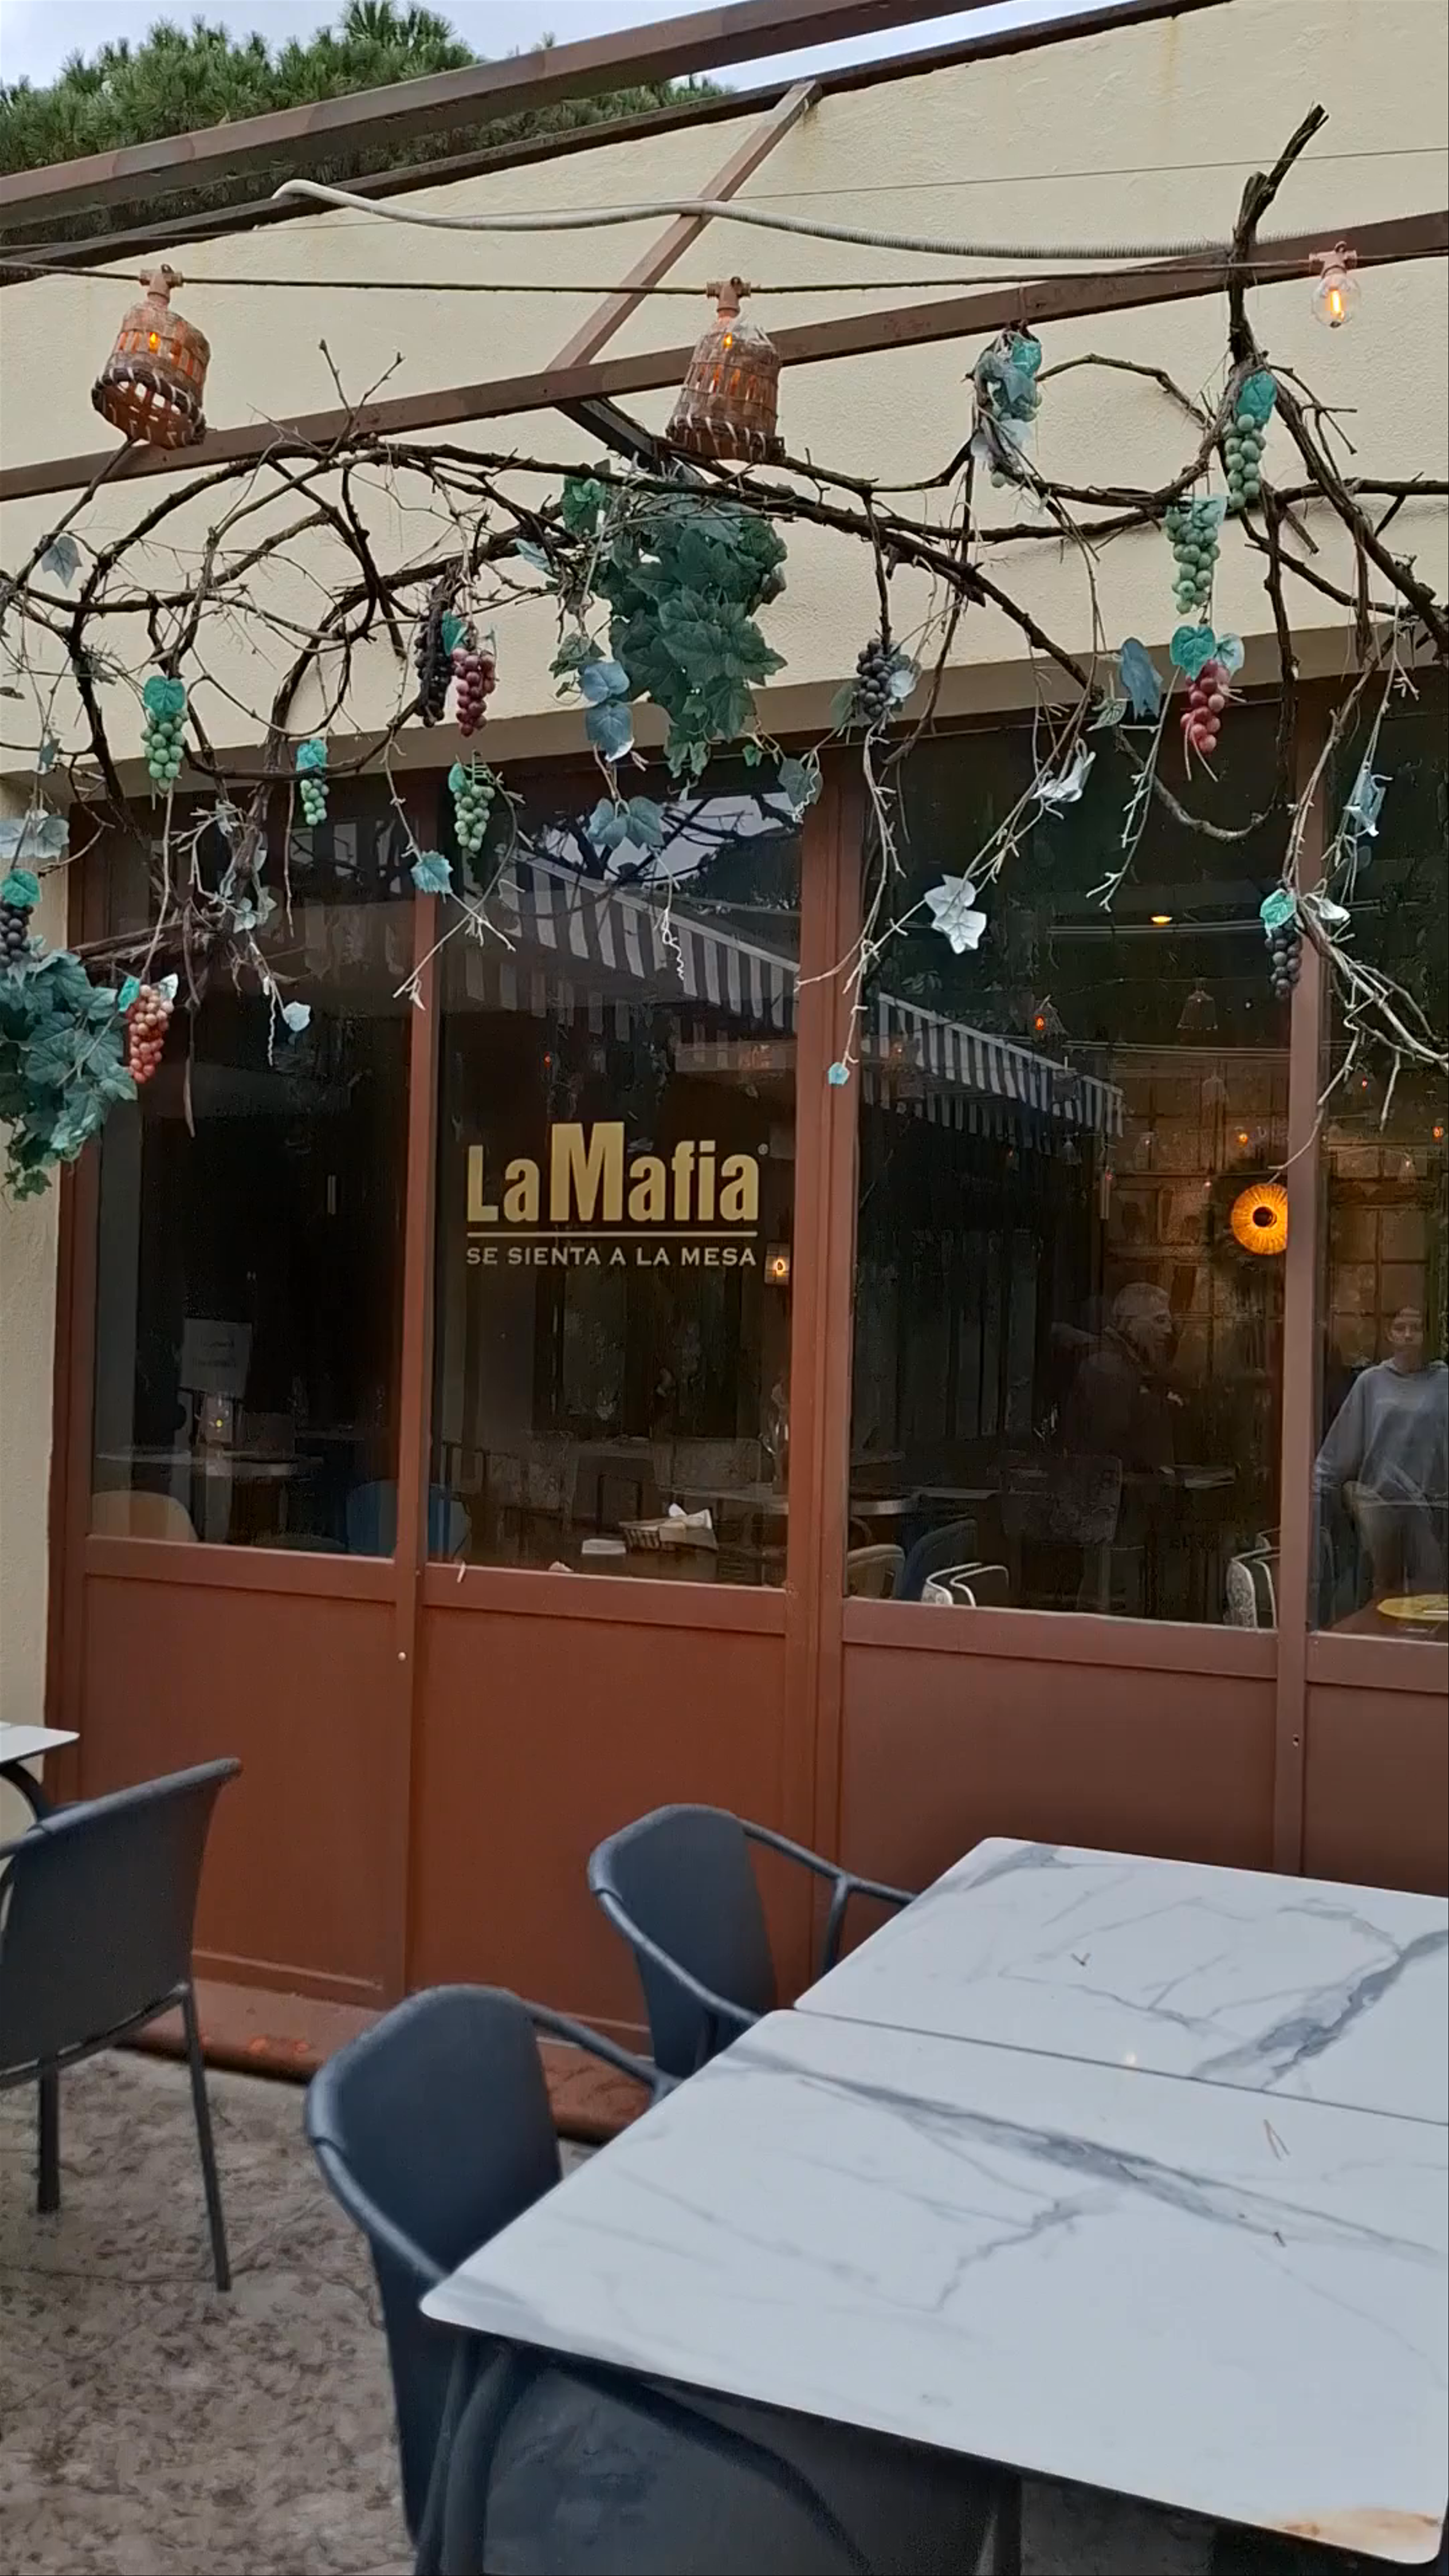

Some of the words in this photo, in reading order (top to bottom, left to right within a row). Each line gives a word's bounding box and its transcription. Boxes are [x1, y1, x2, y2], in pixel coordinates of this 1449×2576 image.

[466, 1247, 498, 1265] SE
[508, 1247, 601, 1265] SIENTA
[609, 1247, 626, 1265] A
[637, 1247, 670, 1266] LA
[681, 1247, 757, 1266] MESA
